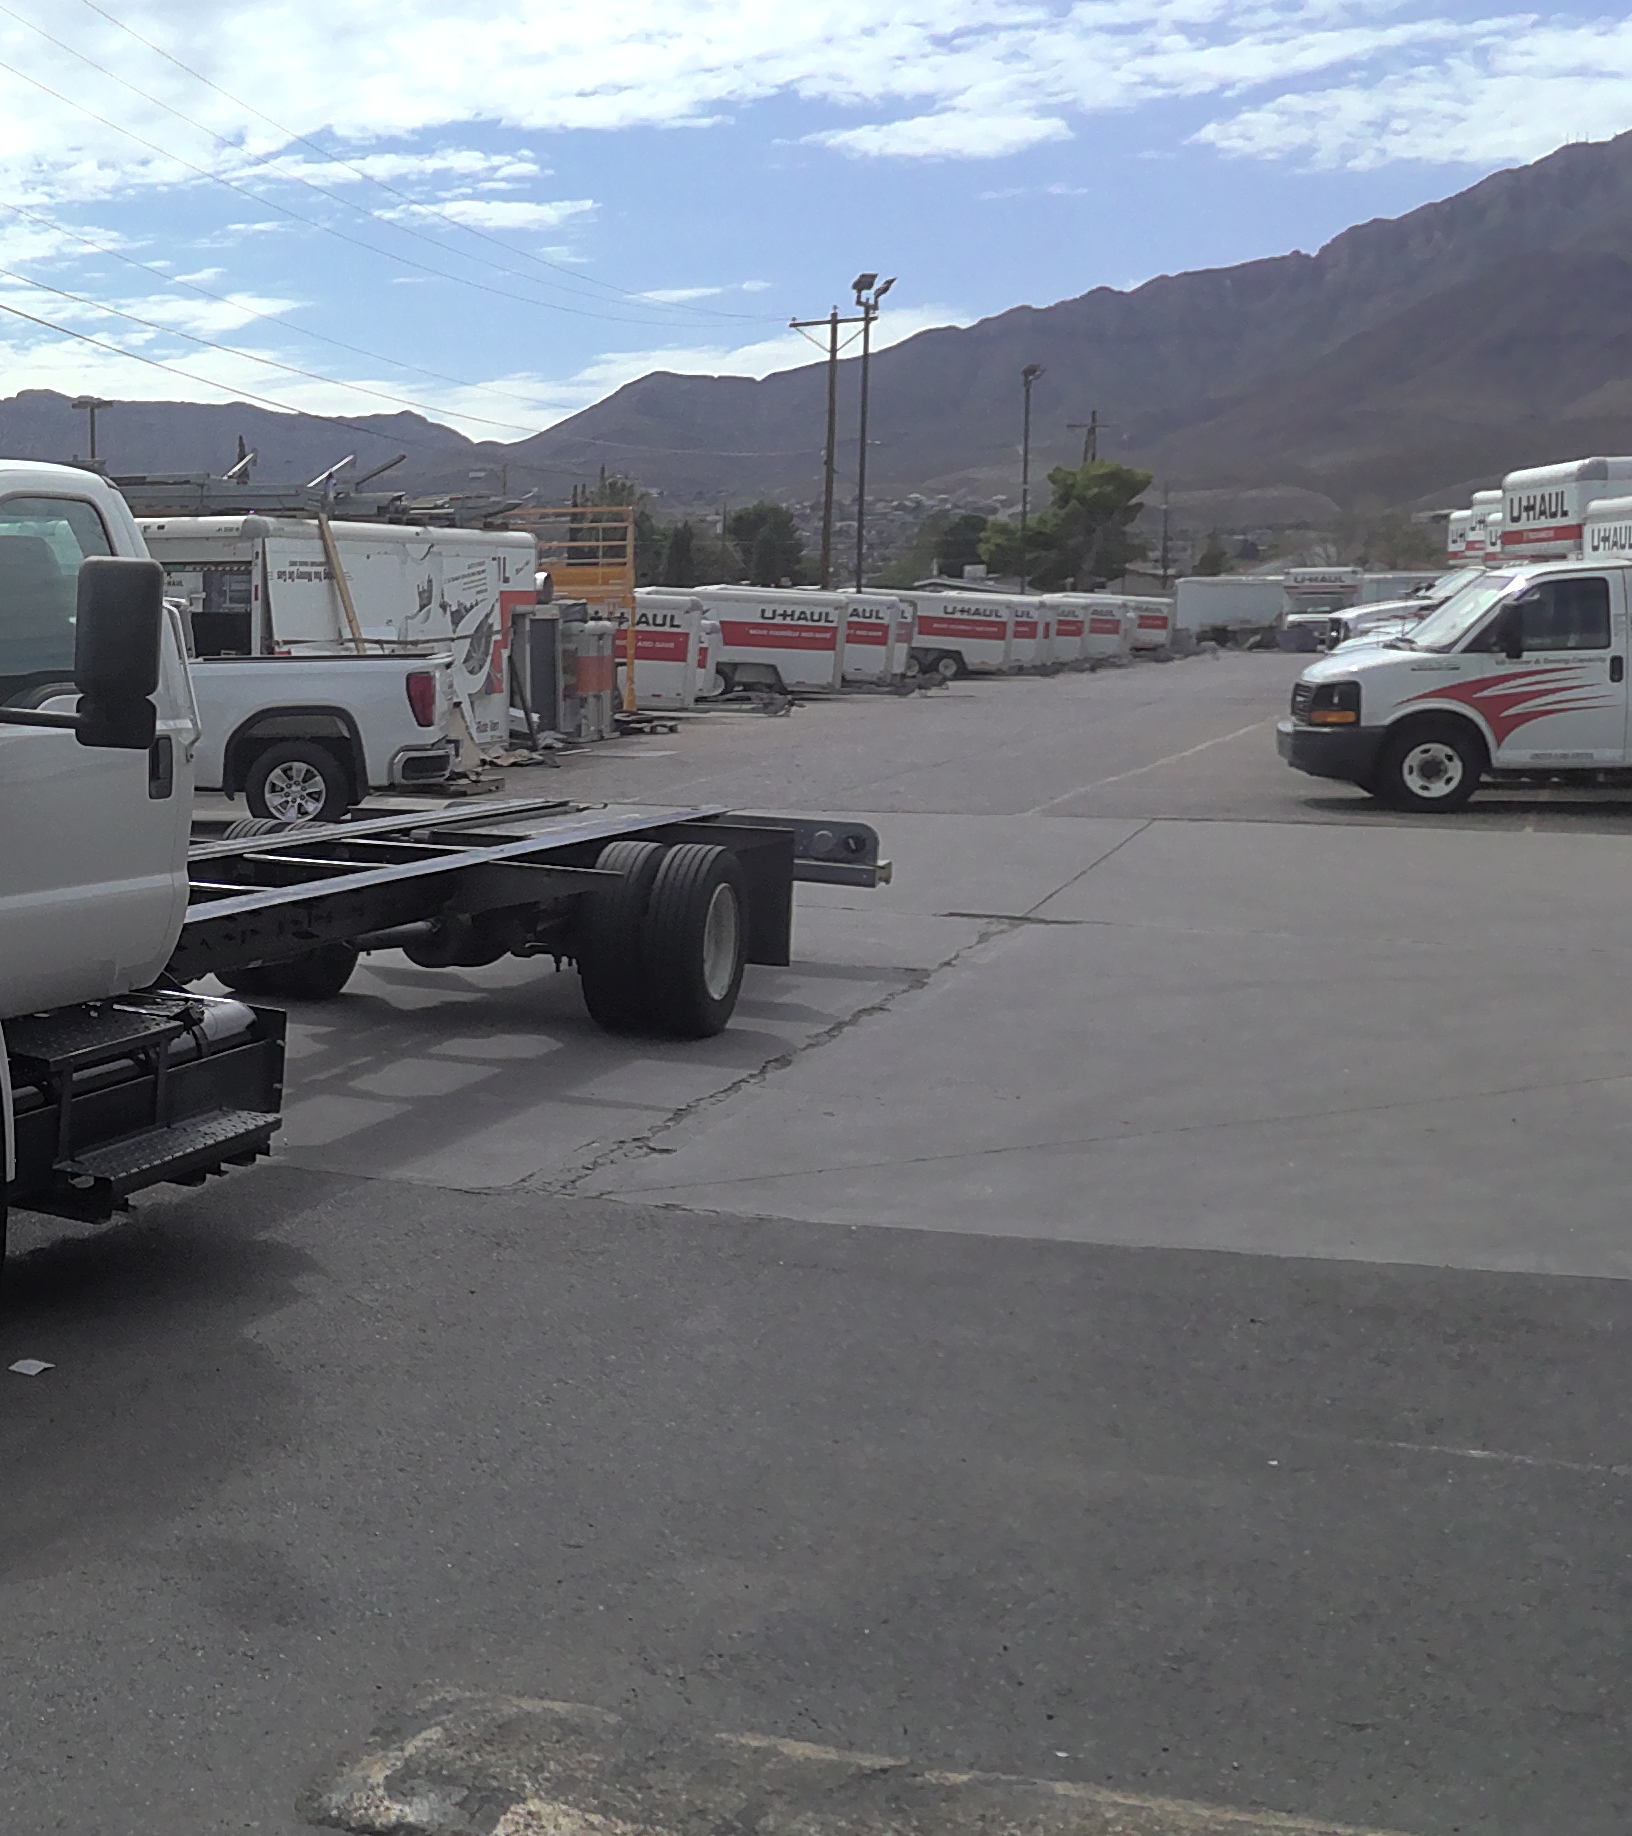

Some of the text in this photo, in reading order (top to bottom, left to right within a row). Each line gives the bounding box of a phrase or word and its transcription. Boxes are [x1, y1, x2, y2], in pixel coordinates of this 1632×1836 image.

[1510, 490, 1569, 523] U-HAUL
[761, 608, 834, 623] U-HAUL
[849, 608, 884, 620] AUL
[943, 605, 1002, 618] U-HAUL
